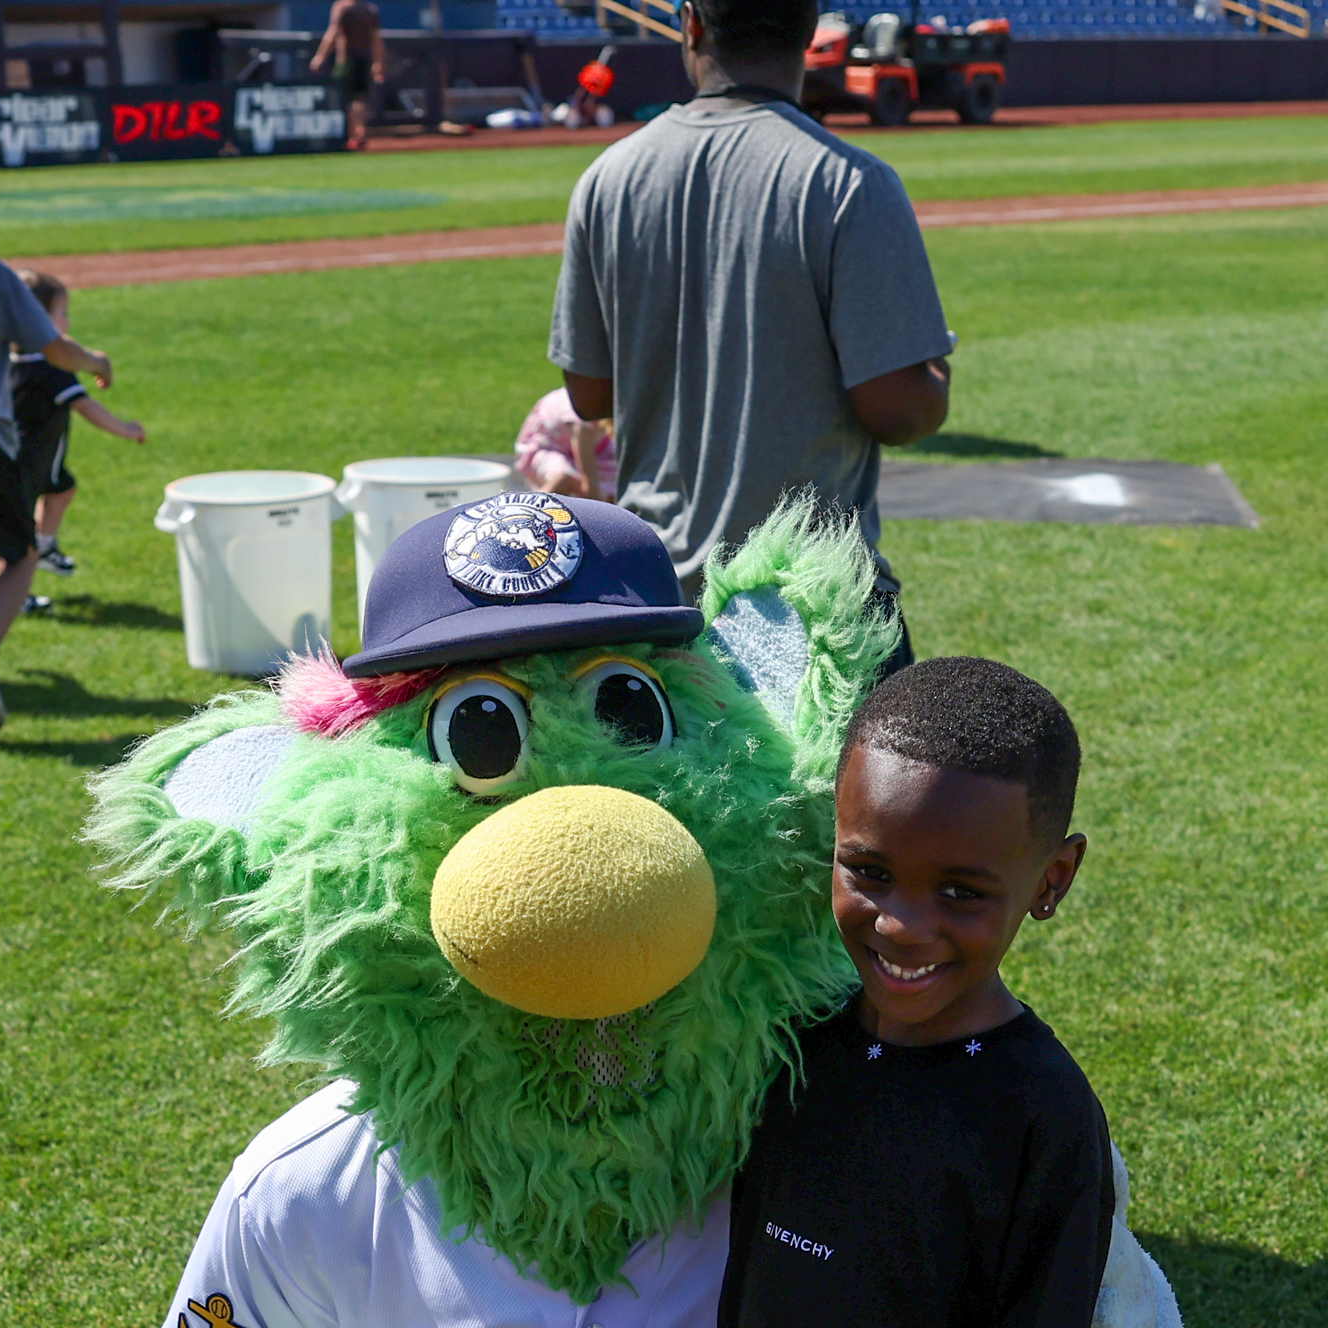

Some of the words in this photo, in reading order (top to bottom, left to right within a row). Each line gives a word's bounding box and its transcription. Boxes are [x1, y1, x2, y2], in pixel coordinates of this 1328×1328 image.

[112, 100, 222, 144] DTLR
[473, 492, 549, 515] CAPTAINS
[463, 566, 494, 590] LAKE
[502, 565, 556, 592] COUNTY
[766, 1221, 835, 1260] GIVENCHY
